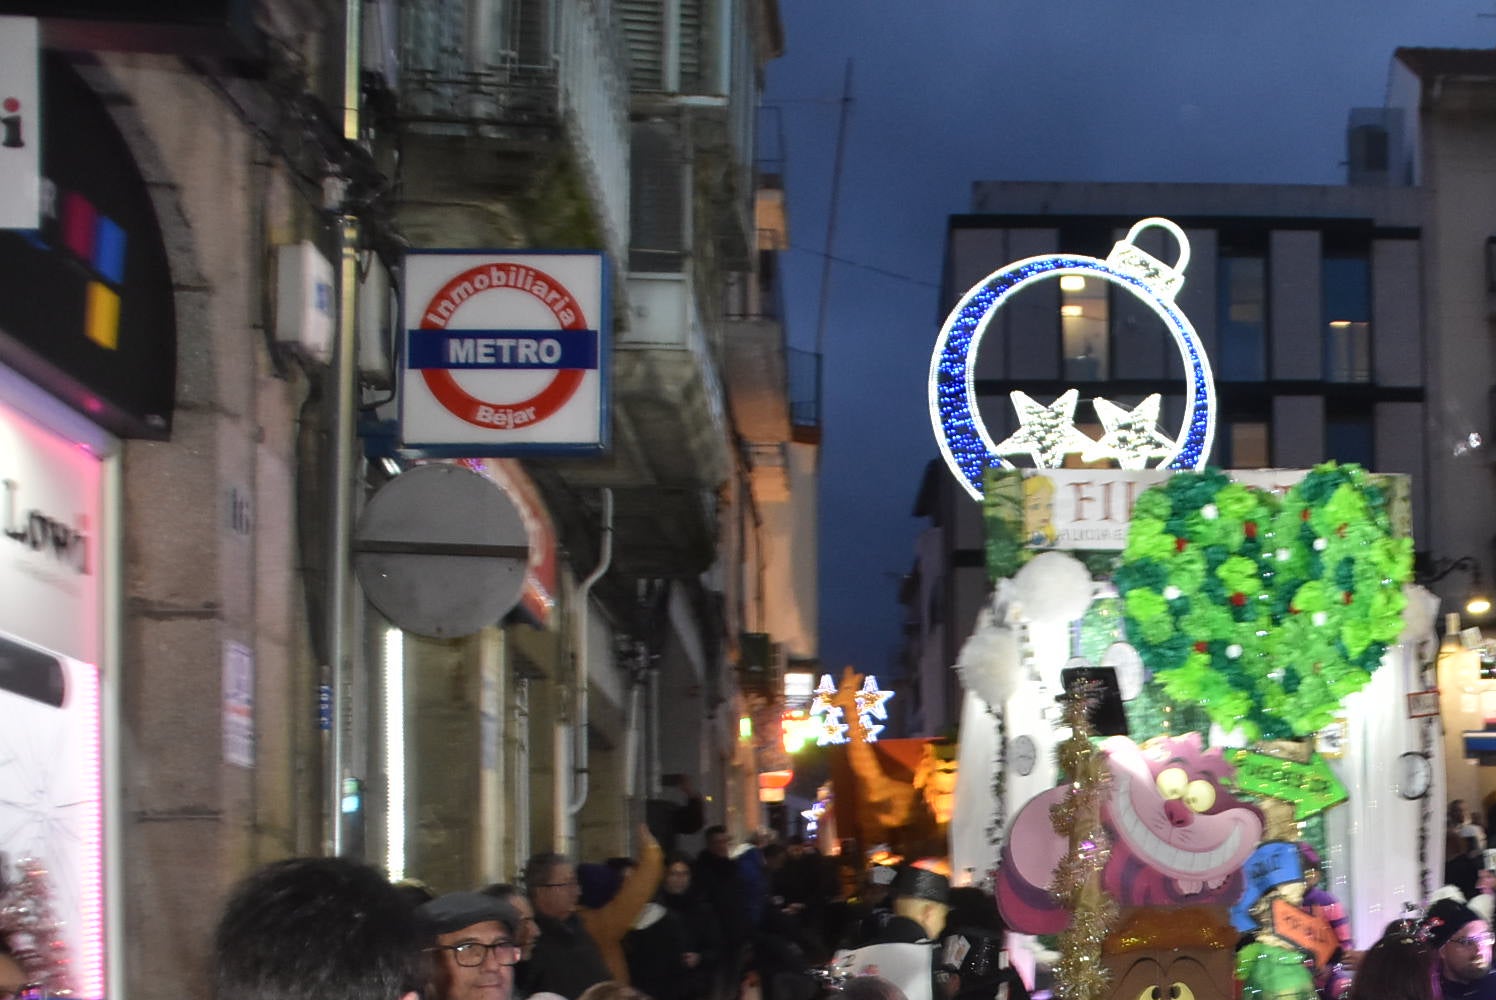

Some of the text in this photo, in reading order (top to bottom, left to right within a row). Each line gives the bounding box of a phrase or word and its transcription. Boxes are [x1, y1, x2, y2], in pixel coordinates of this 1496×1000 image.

[426, 266, 576, 329] Inmobiliaria
[448, 337, 562, 365] METRO
[475, 404, 537, 429] Béjar
